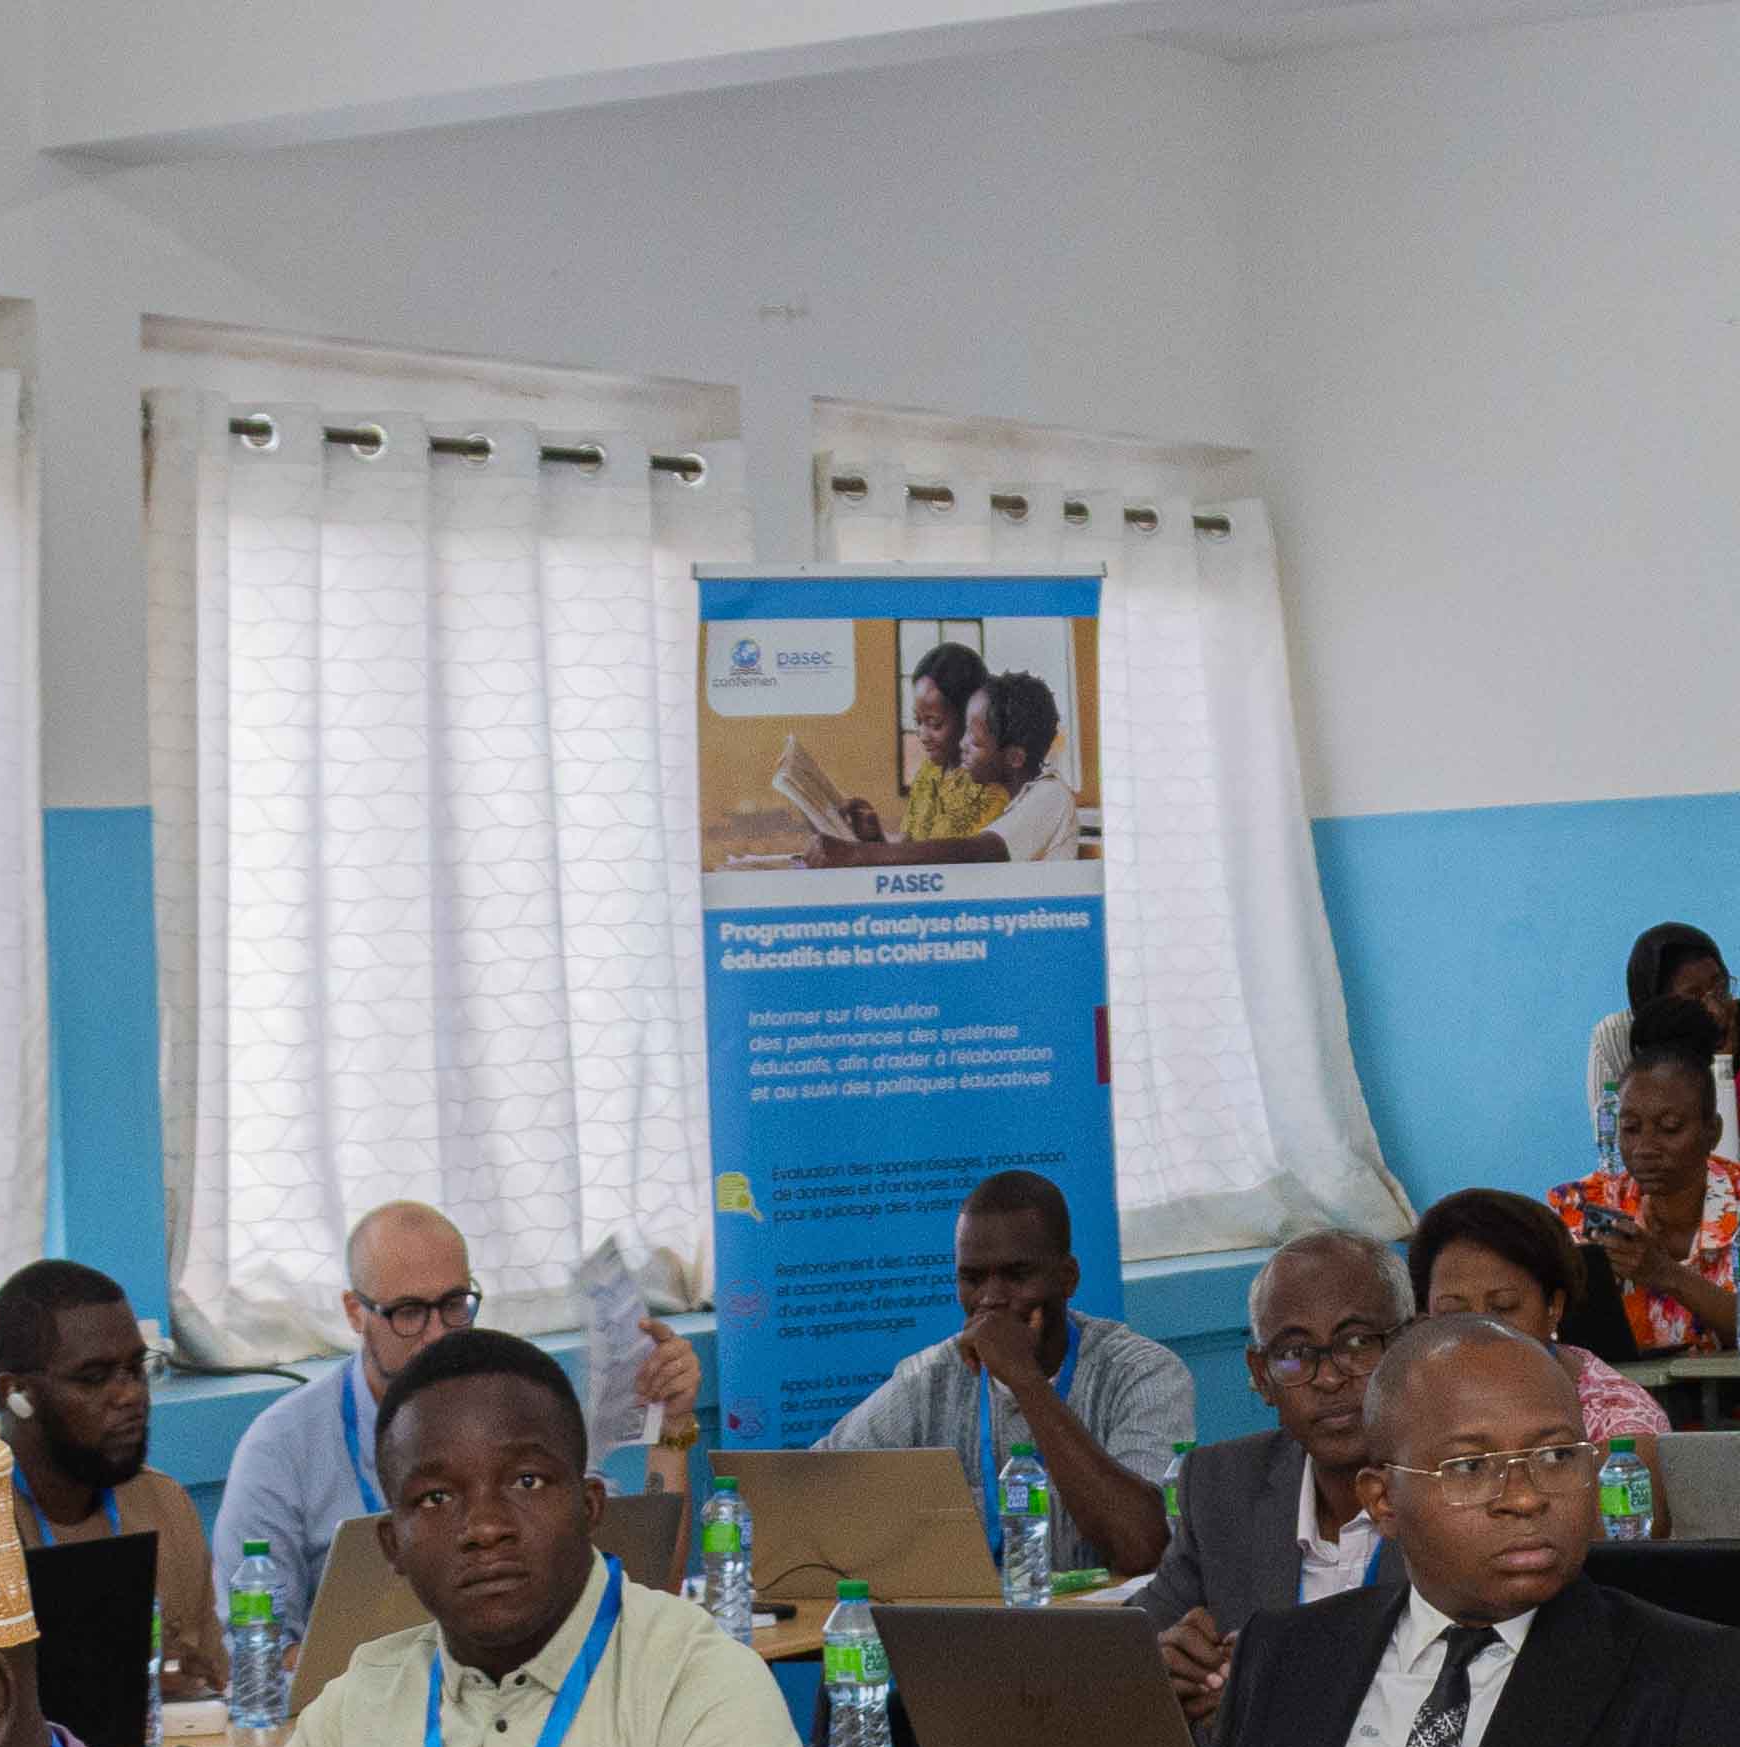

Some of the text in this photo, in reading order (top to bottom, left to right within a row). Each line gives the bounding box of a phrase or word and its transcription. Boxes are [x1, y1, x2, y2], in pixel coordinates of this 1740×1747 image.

[777, 650, 834, 668] pasec
[875, 873, 944, 894] PASEC
[720, 921, 849, 945] Programme
[954, 911, 990, 932] des
[993, 907, 1090, 936] systèmes
[721, 940, 988, 971] éducatifs de la CONFEMEN
[749, 1007, 823, 1028] Informer
[826, 1009, 850, 1024] sur
[749, 1035, 782, 1052] des
[787, 1030, 903, 1054] performances
[908, 1027, 937, 1043] des
[750, 1085, 769, 1101] et
[774, 1084, 797, 1100] au
[842, 1079, 871, 1095] des
